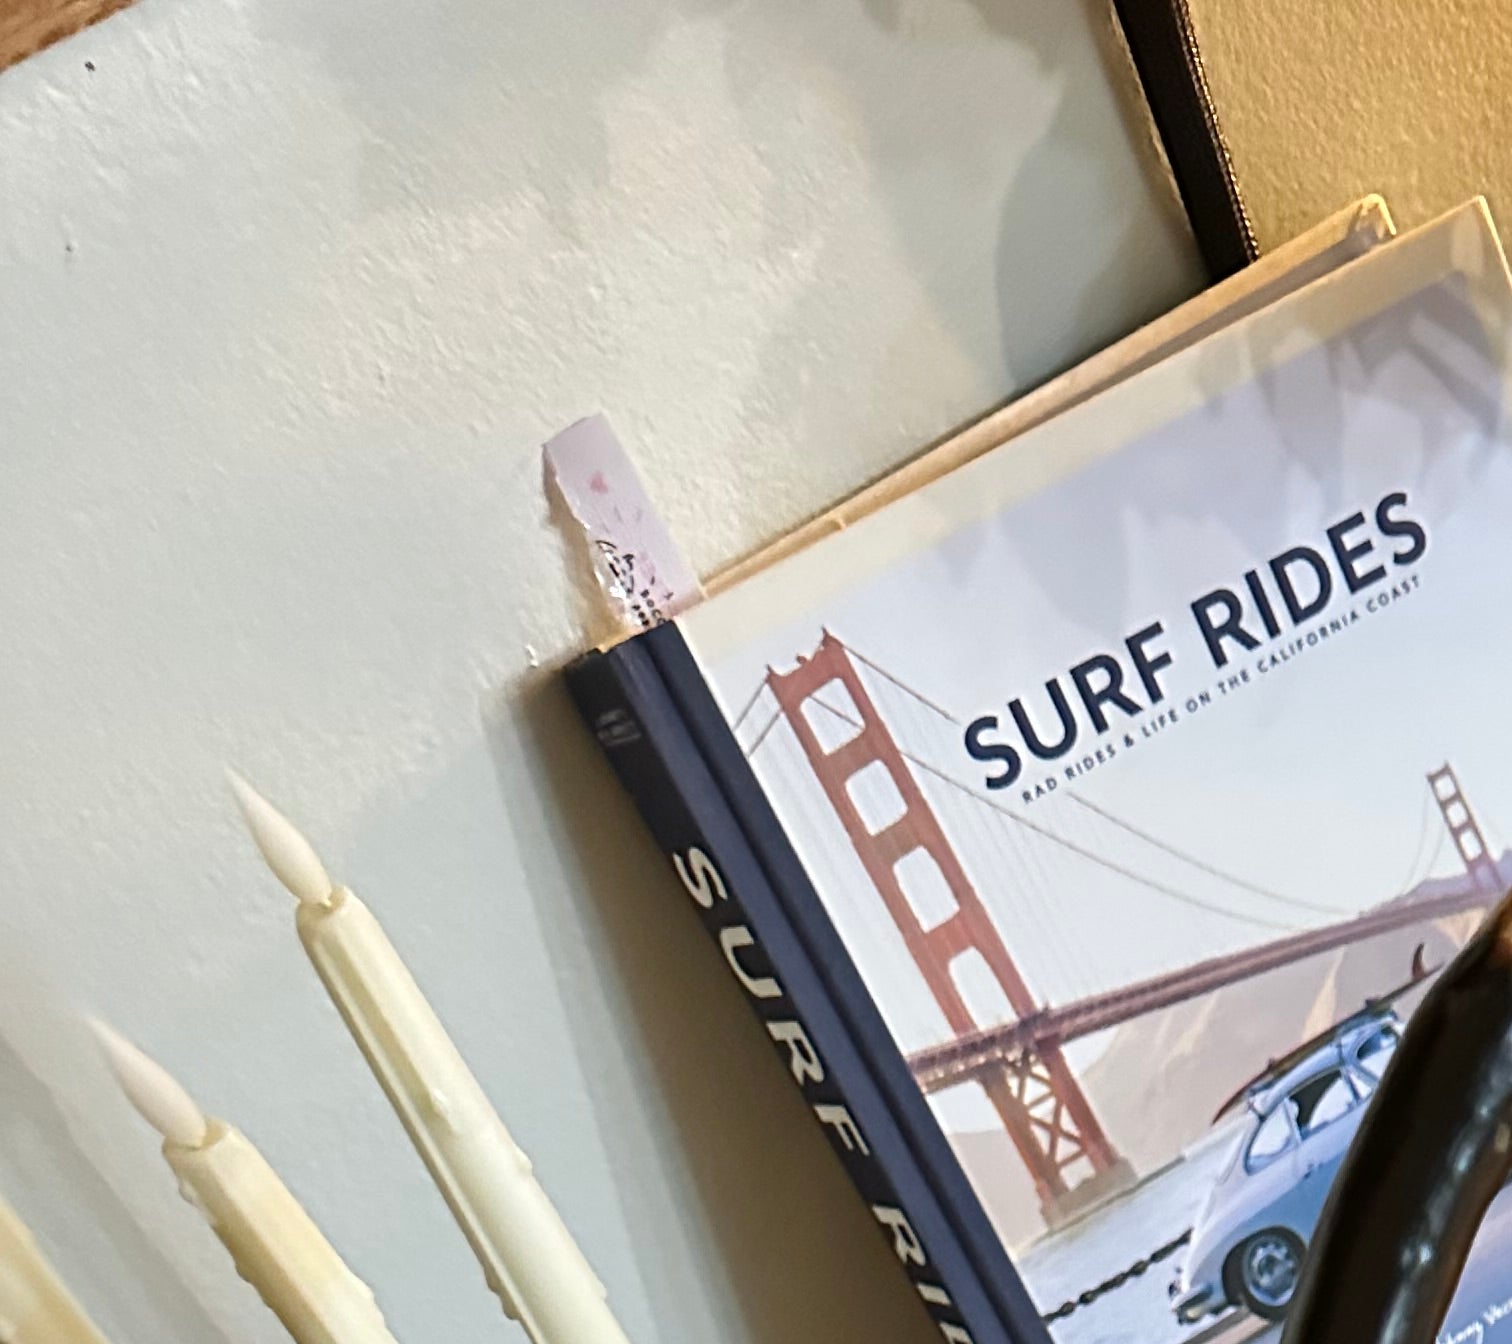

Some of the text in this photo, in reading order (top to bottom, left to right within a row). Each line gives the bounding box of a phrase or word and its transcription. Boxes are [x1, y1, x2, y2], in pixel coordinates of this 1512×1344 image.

[964, 491, 1427, 790] SURF RIDES
[1022, 574, 1423, 804] RAD RIDES & LIFE ON THE CALIFORNIA COAST
[673, 846, 870, 1159] SURF
